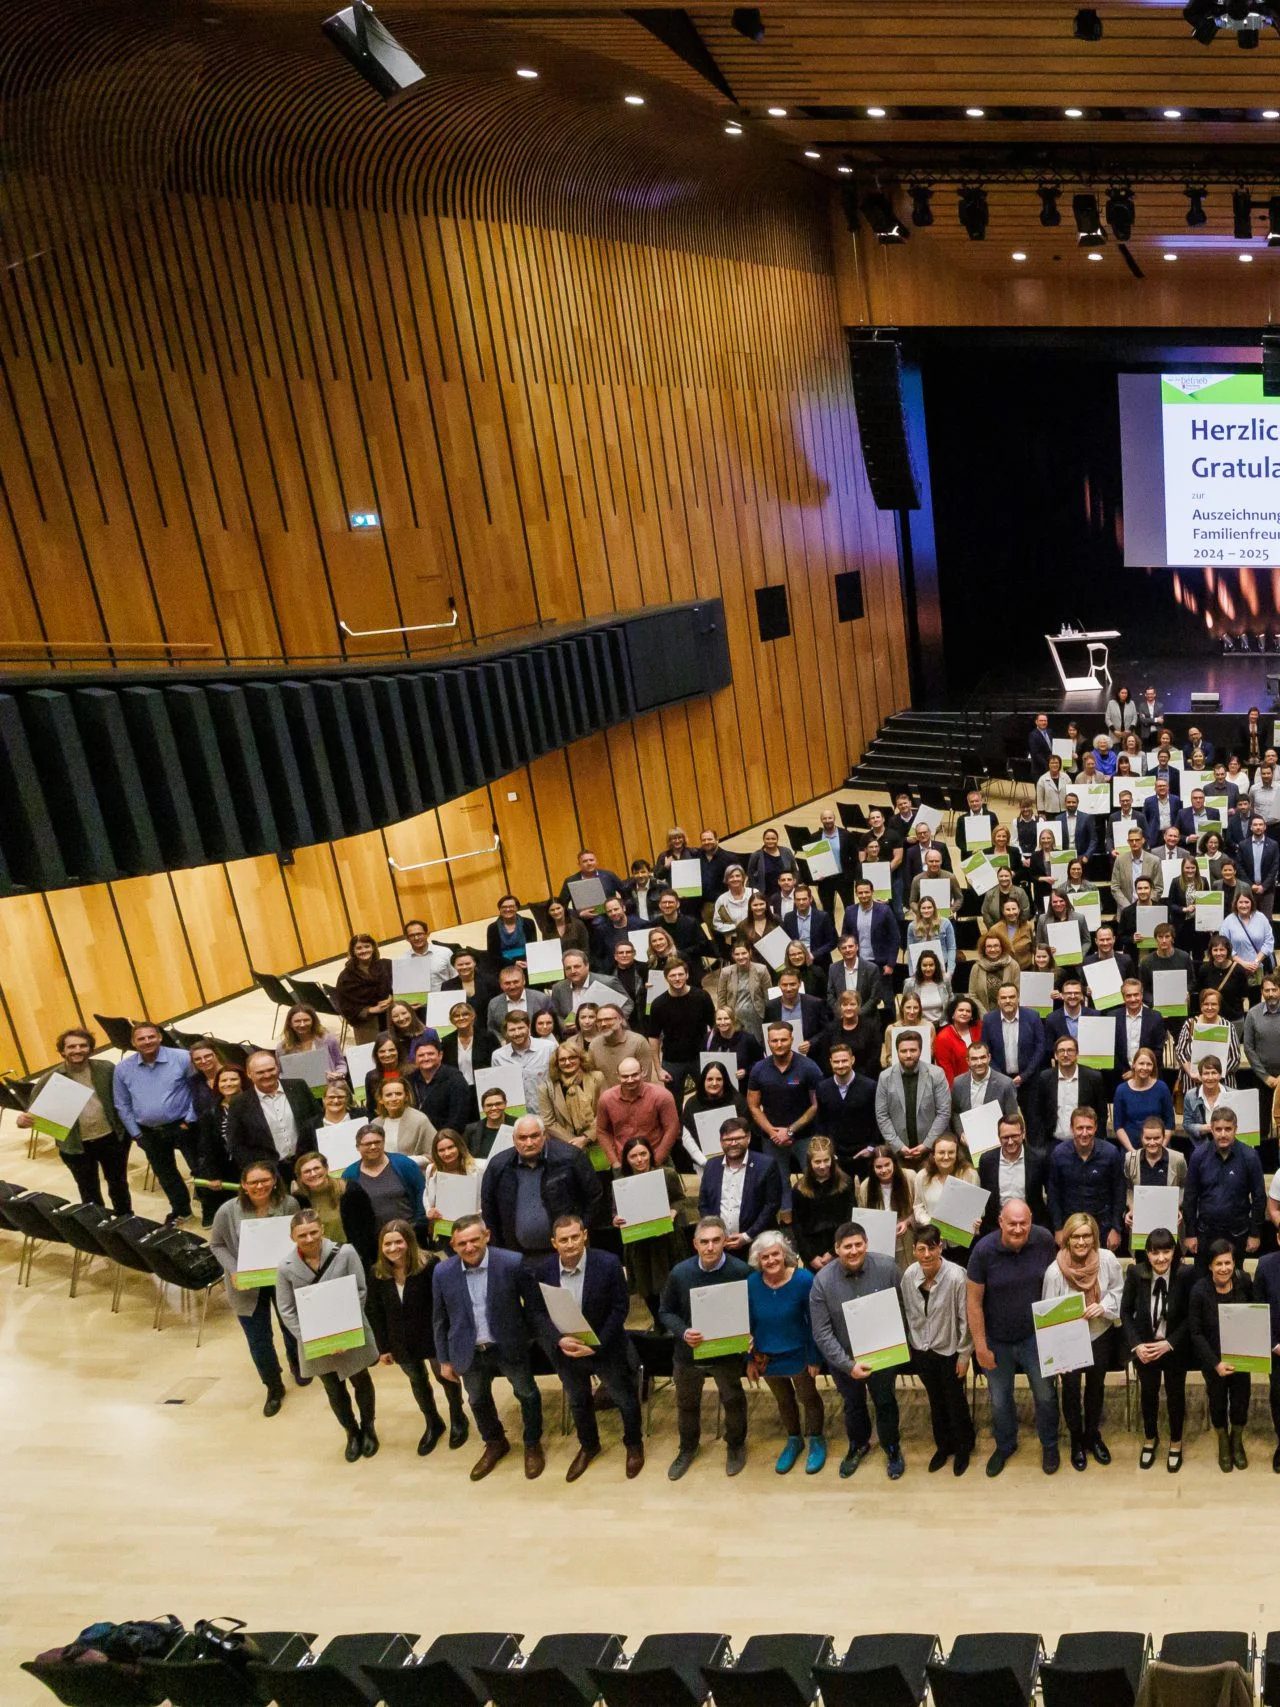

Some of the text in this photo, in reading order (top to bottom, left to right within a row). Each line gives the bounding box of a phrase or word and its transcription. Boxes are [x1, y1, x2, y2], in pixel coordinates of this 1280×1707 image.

[1191, 492, 1206, 500] zur
[1193, 548, 1224, 560] 2024
[1239, 548, 1270, 561] 2025
